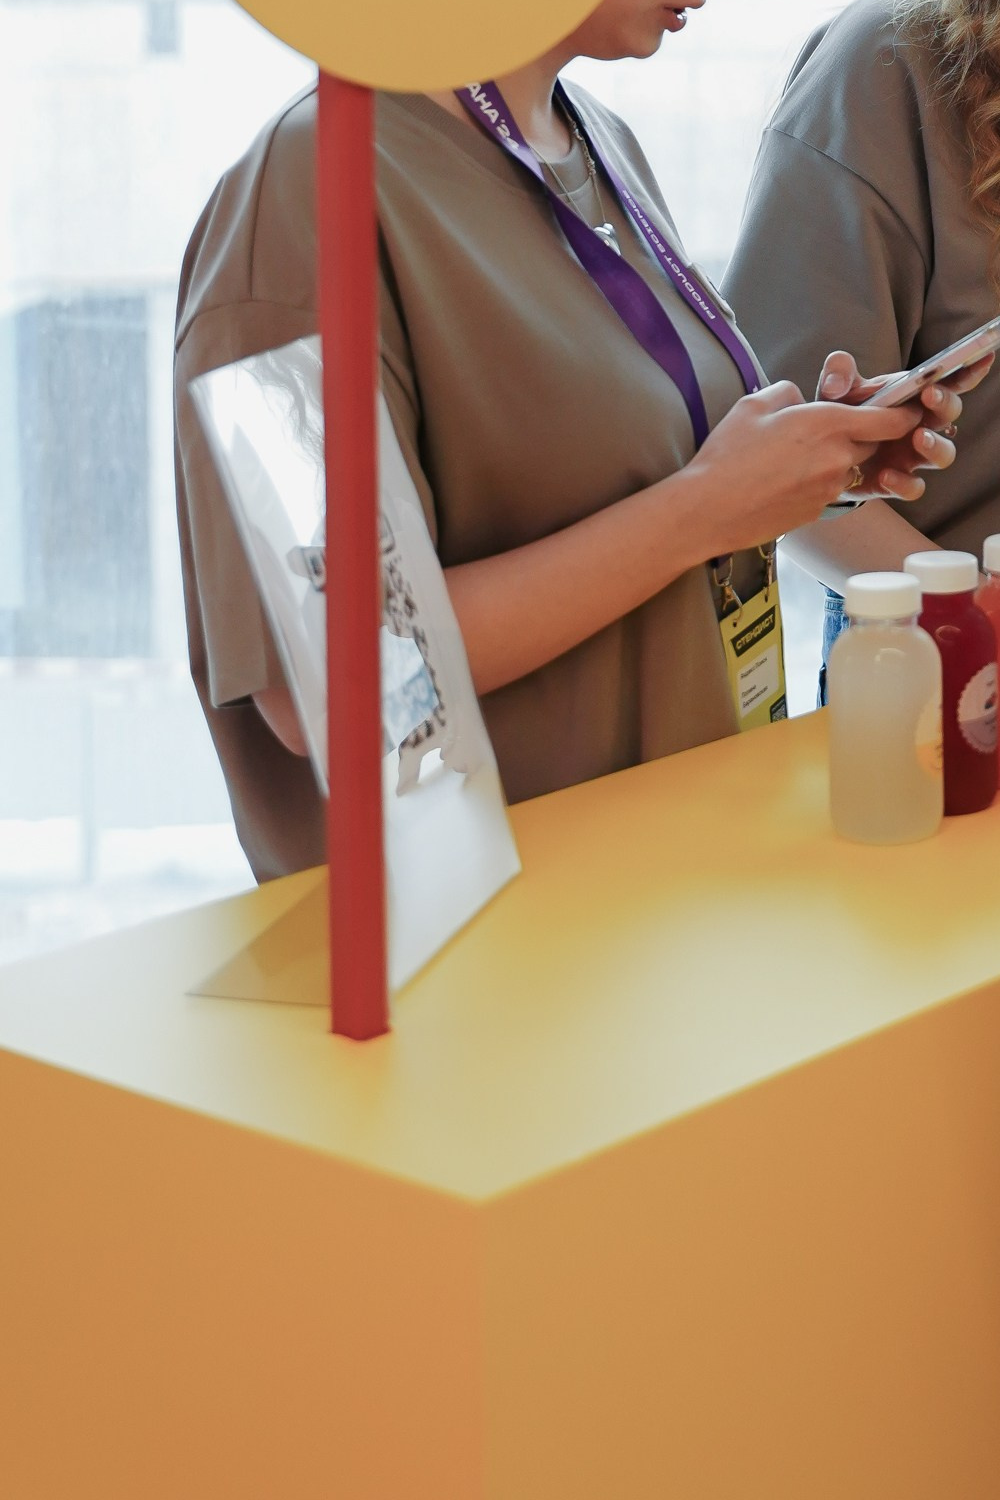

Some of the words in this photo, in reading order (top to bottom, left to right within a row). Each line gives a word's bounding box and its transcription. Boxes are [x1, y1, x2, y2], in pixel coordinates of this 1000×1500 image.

[464, 81, 520, 150] AHA'24
[622, 189, 667, 253] SCIENCE
[663, 252, 717, 321] PRODUCT
[735, 613, 774, 650] СТЕНДИСТ
